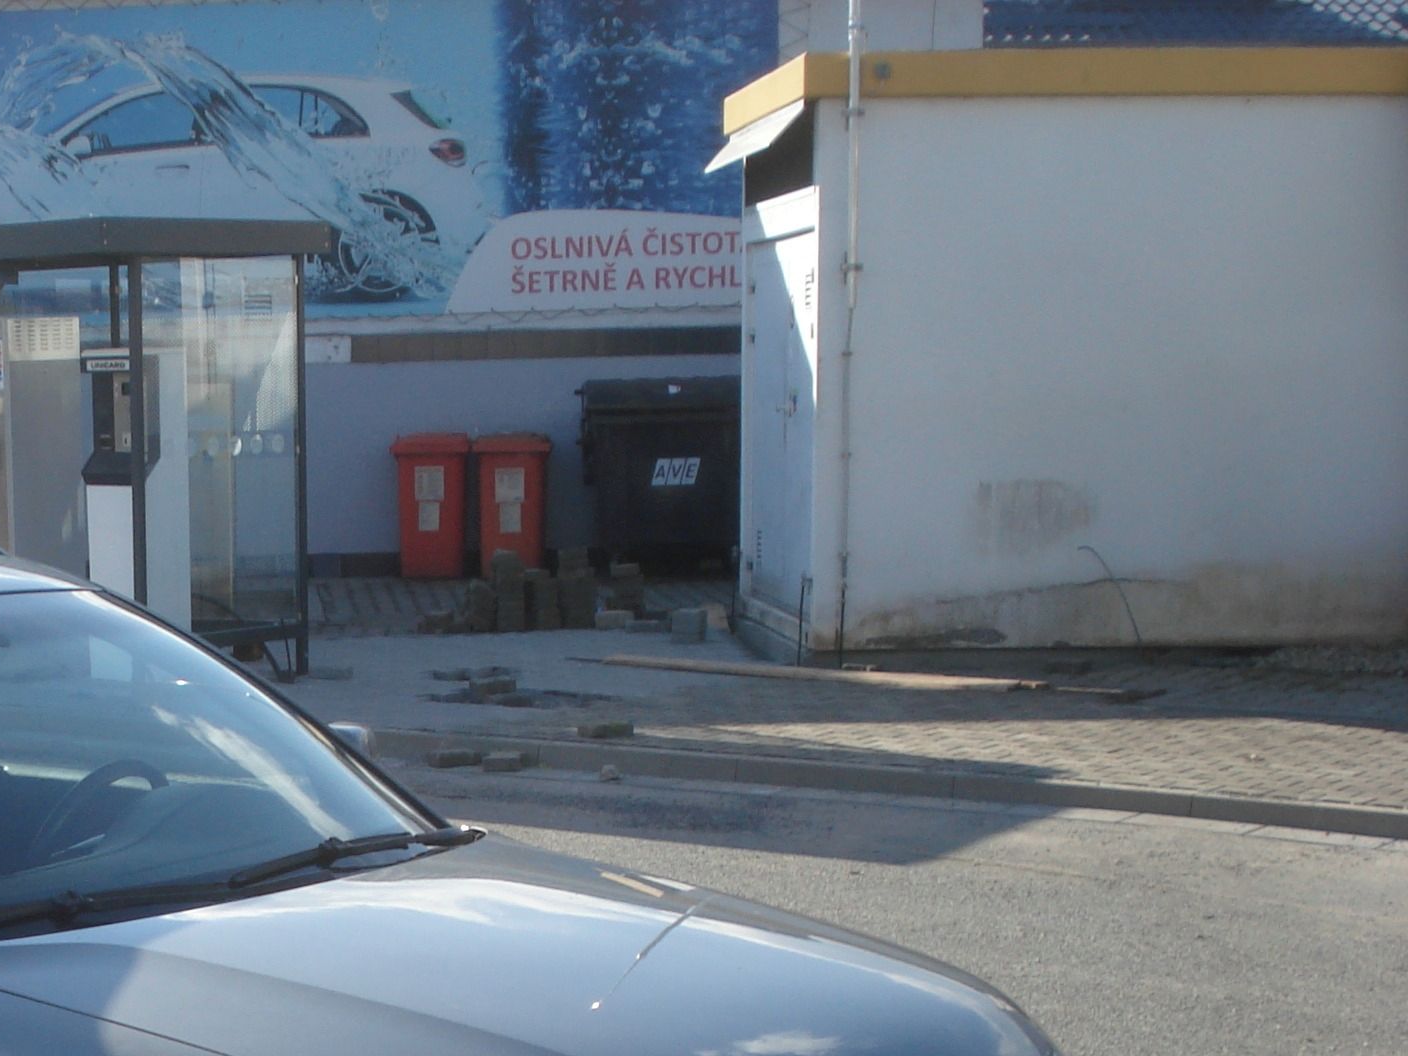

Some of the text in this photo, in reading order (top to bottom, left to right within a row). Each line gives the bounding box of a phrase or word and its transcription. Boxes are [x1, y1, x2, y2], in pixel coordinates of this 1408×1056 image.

[510, 226, 742, 261] OSLNIVÁ ČISTOT
[510, 262, 742, 294] ŠETRNĚ A RYCHL
[655, 463, 698, 479] AVE
